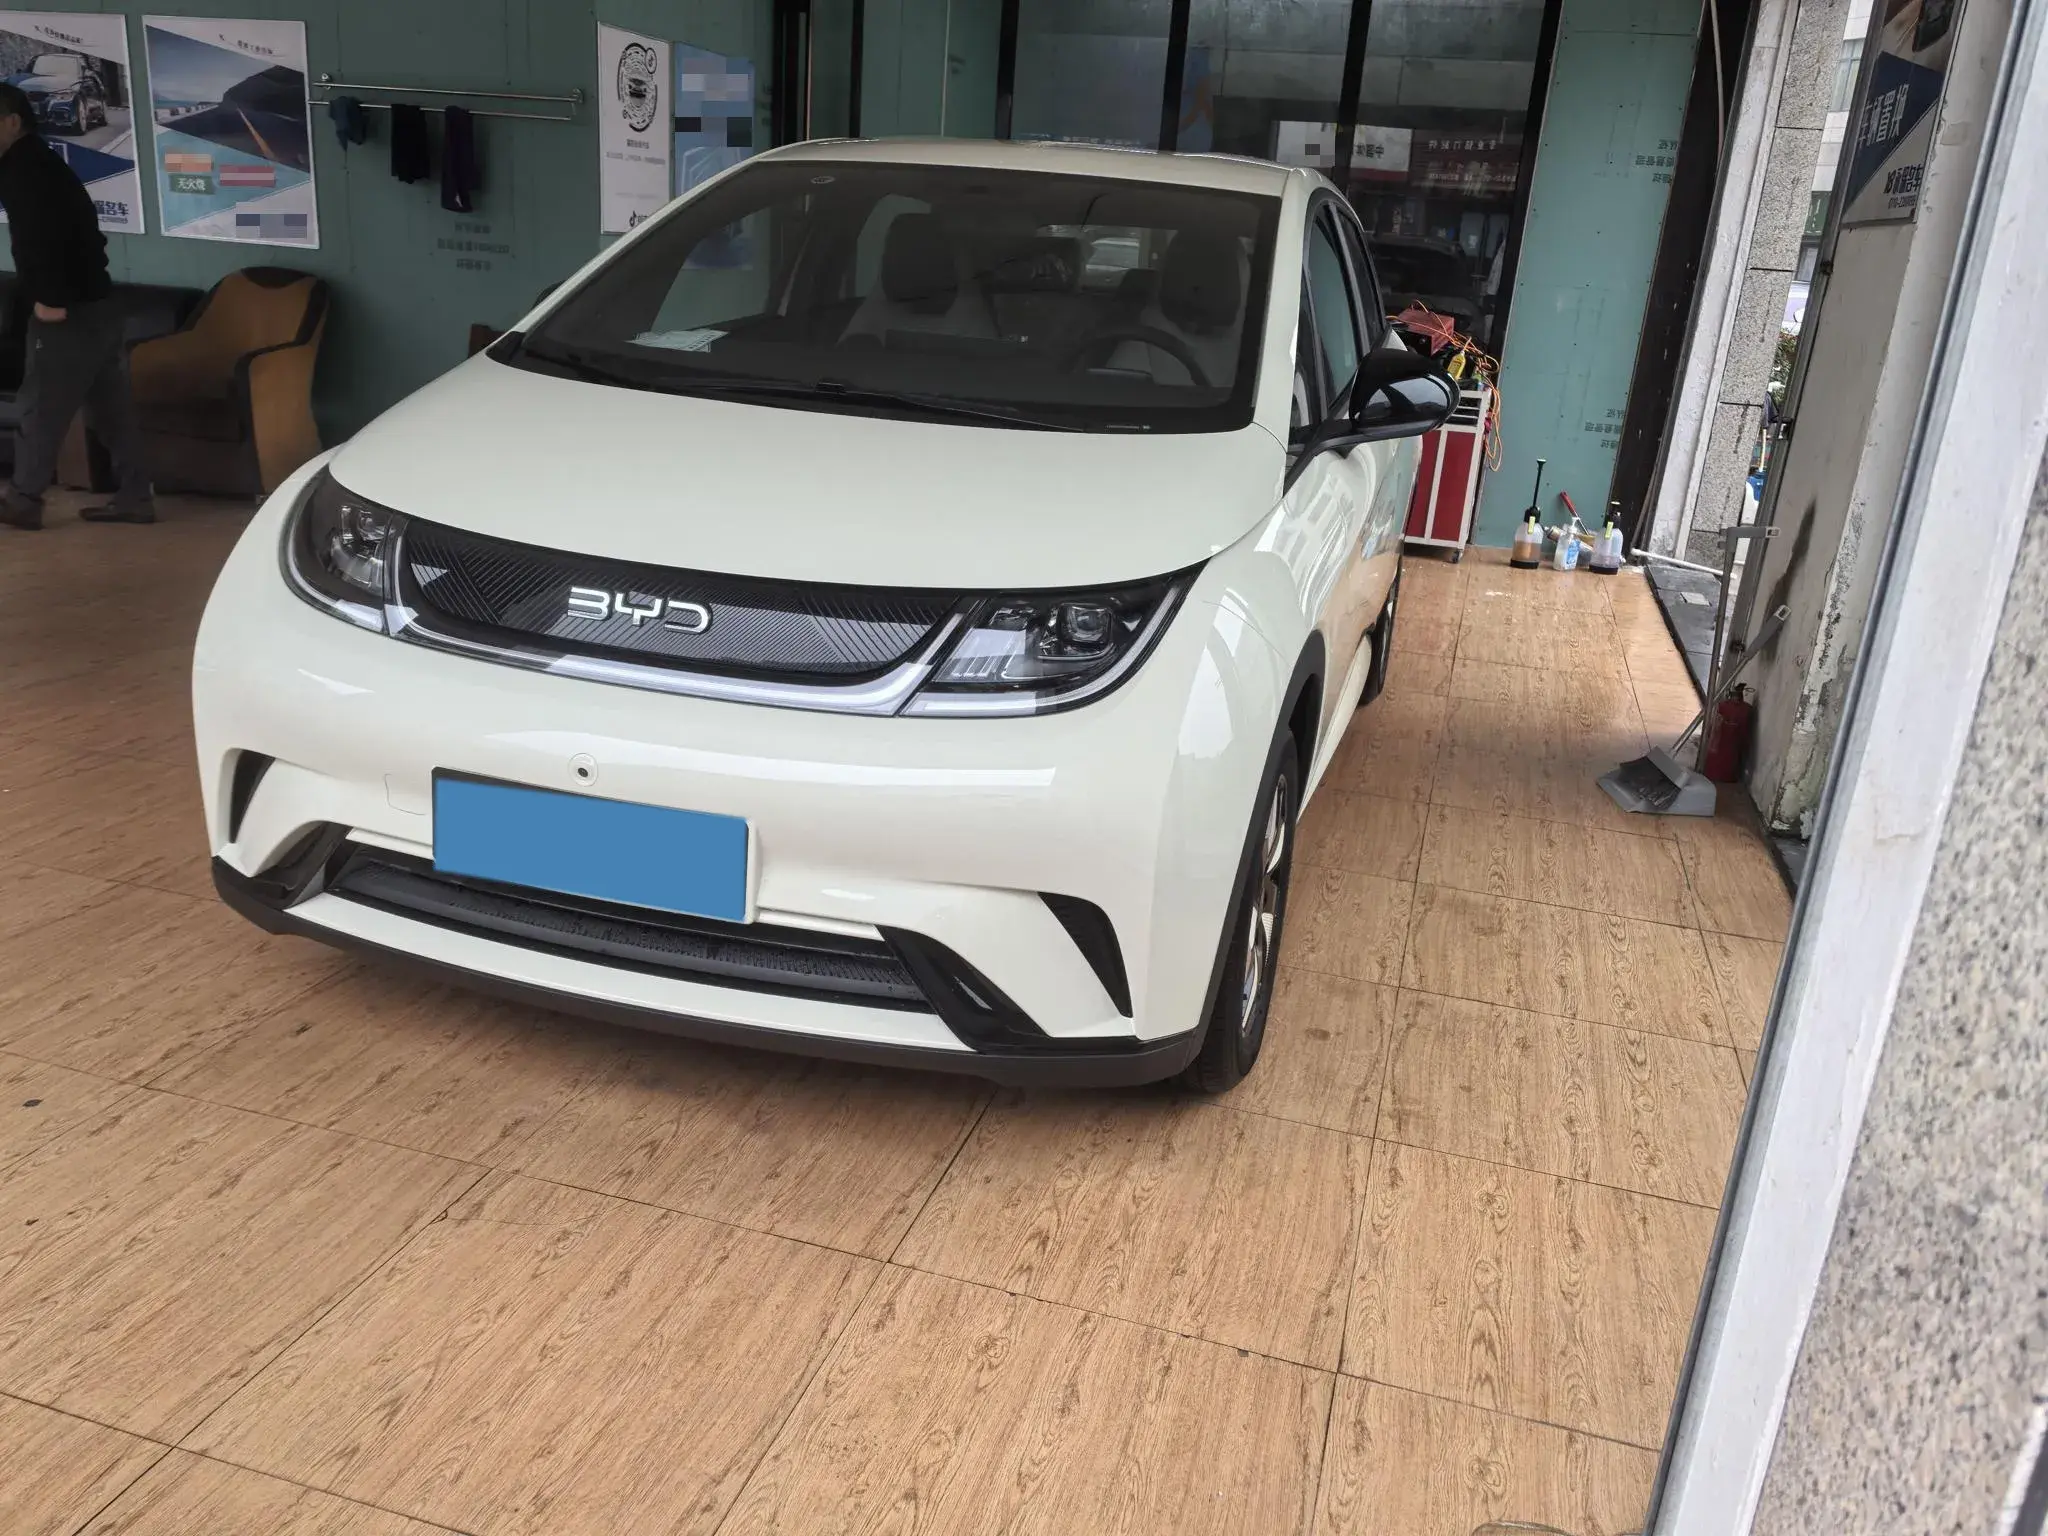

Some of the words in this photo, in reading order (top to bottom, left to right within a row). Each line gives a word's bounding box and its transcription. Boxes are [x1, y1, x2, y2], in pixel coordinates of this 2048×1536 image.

[1857, 83, 1910, 150] 车辆置换
[568, 586, 714, 634] BYD
